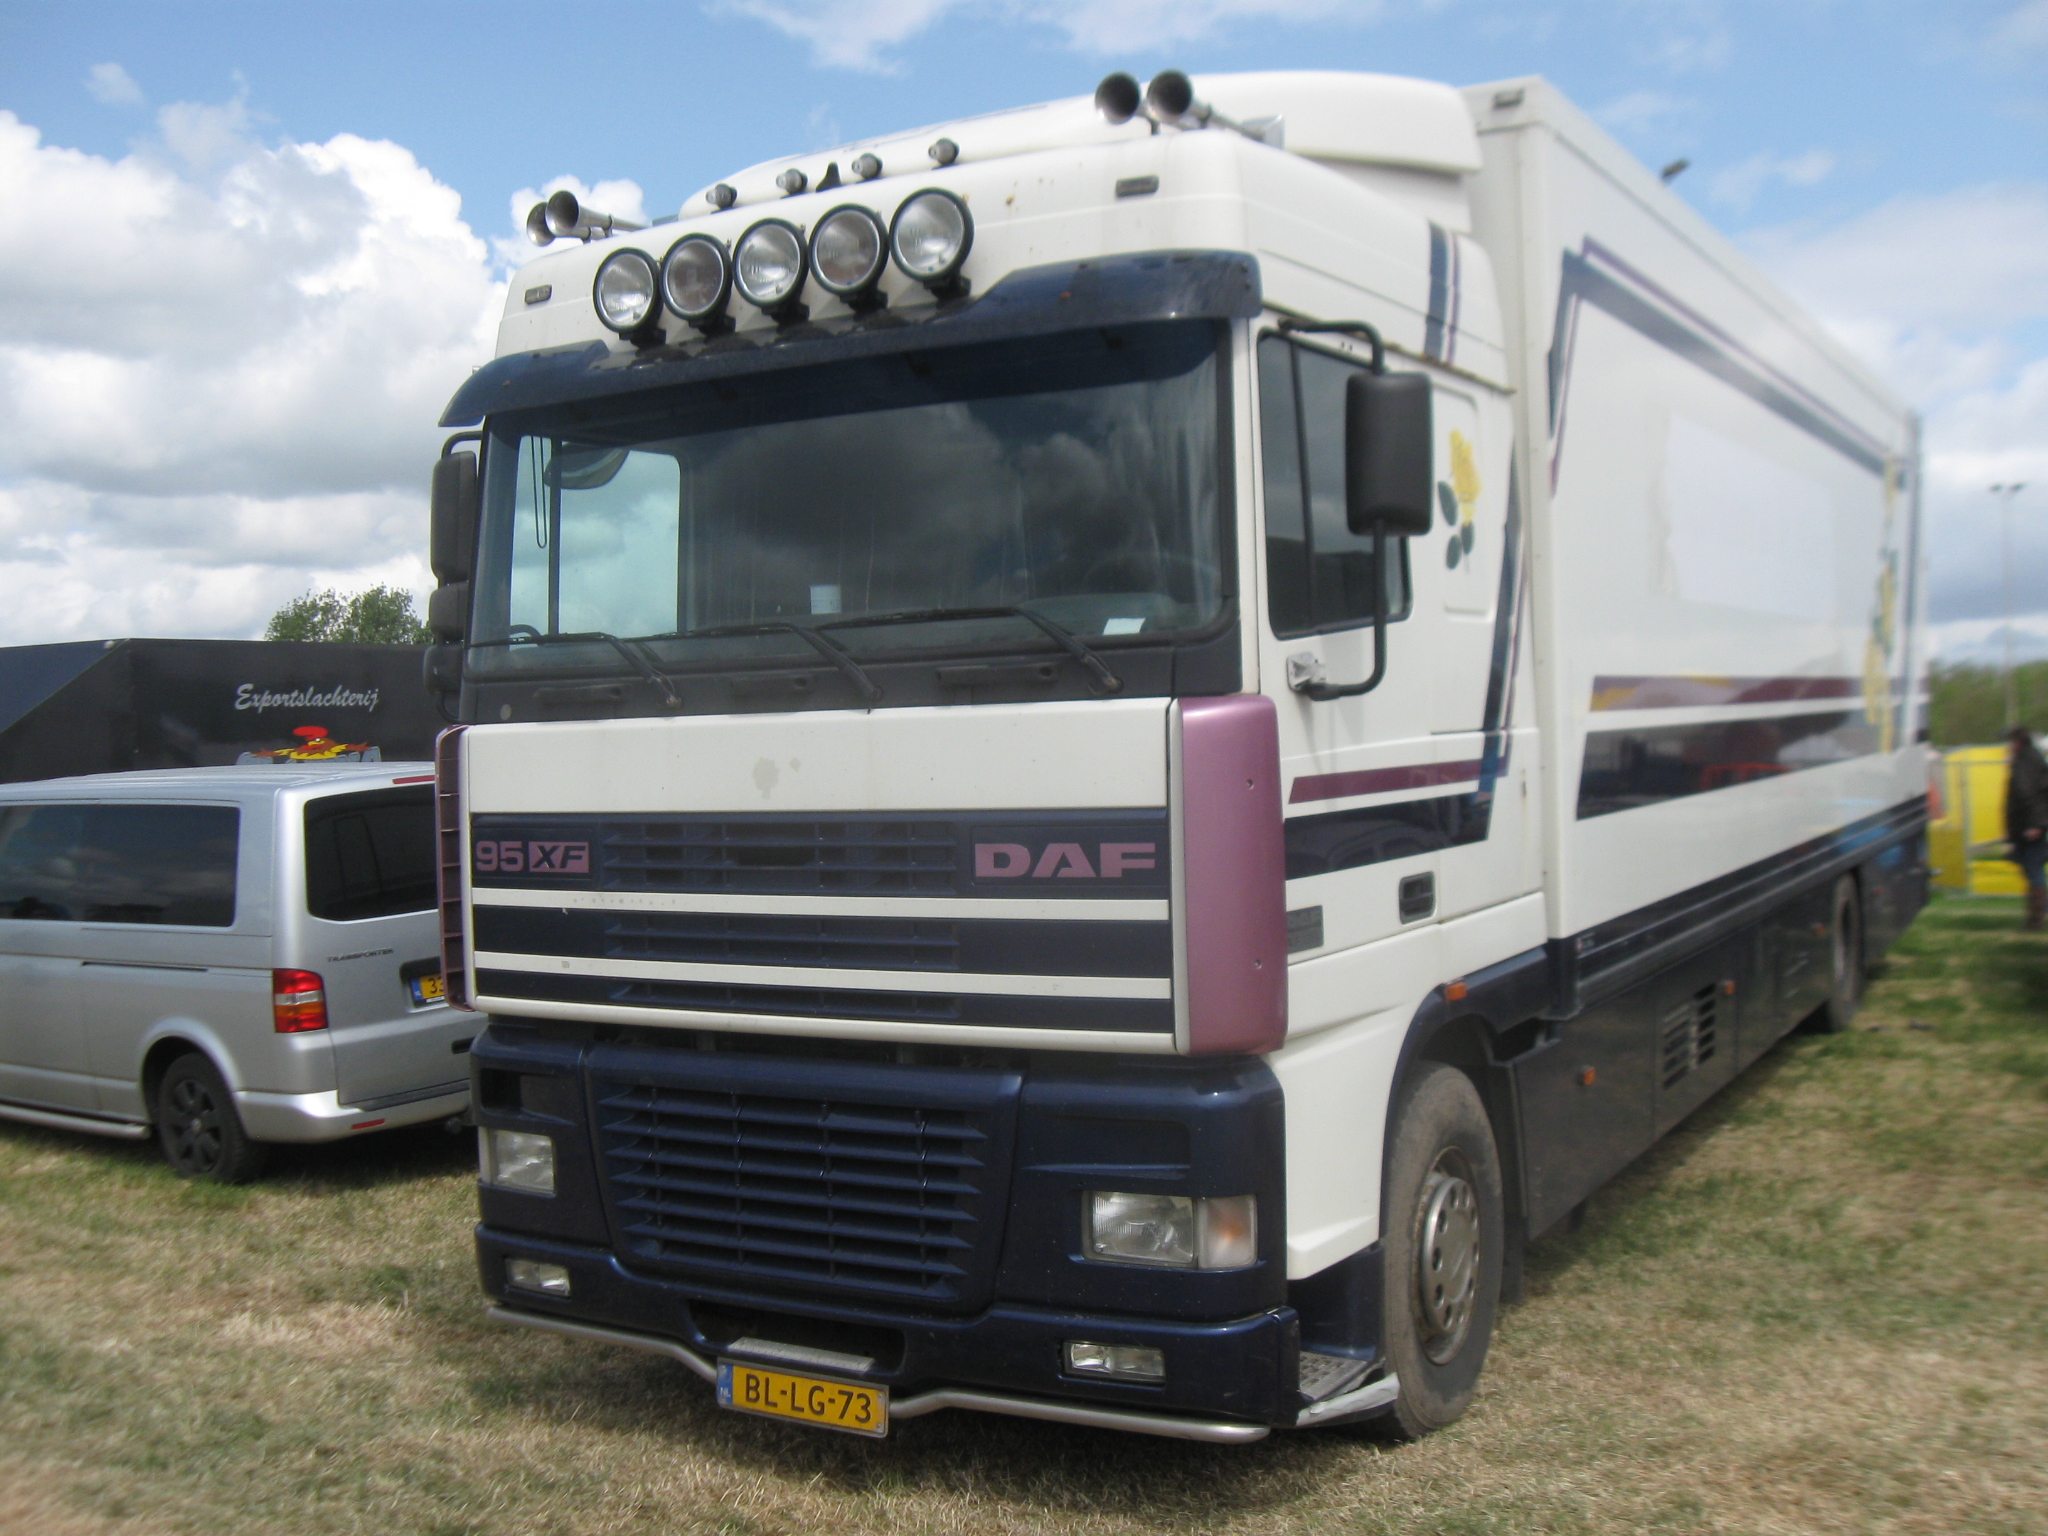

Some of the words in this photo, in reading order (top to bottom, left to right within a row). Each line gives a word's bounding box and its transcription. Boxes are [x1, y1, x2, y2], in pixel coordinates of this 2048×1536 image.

[234, 683, 379, 713] Exportslachterij
[975, 842, 1156, 878] DAF
[745, 1373, 871, 1424] BL-LG-73
